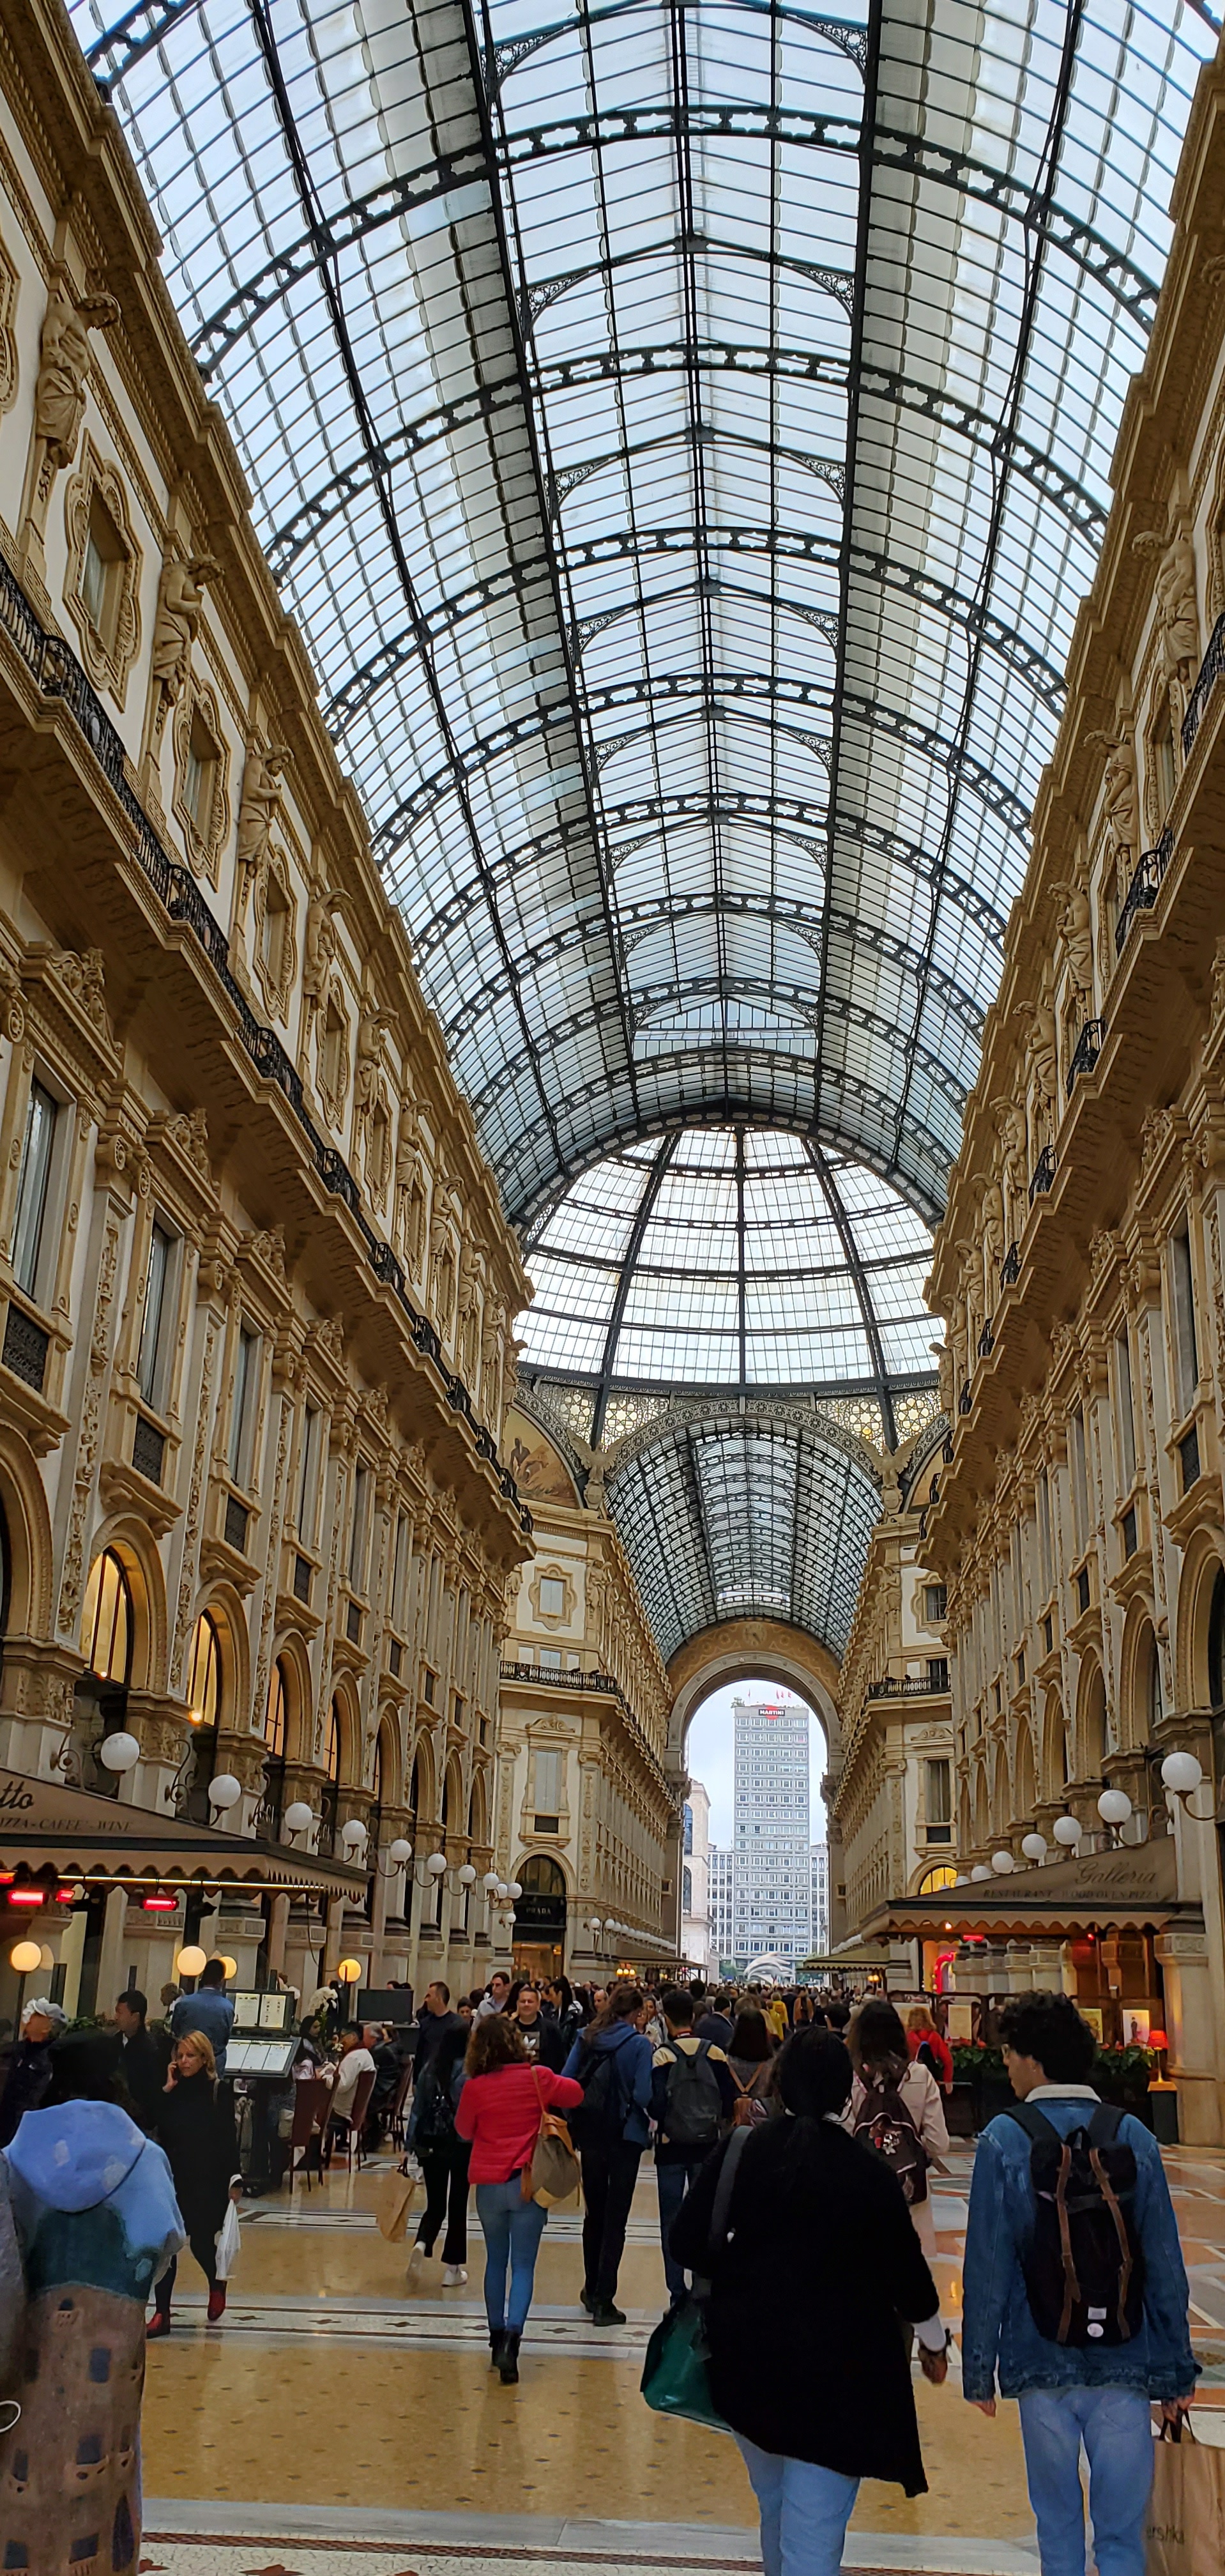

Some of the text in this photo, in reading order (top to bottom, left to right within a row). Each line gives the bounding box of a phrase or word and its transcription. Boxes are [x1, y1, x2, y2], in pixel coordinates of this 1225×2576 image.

[98, 1821, 132, 1832] WINE
[1075, 1860, 1156, 1885] Galleria
[984, 1889, 1054, 1899] RESTAURANT
